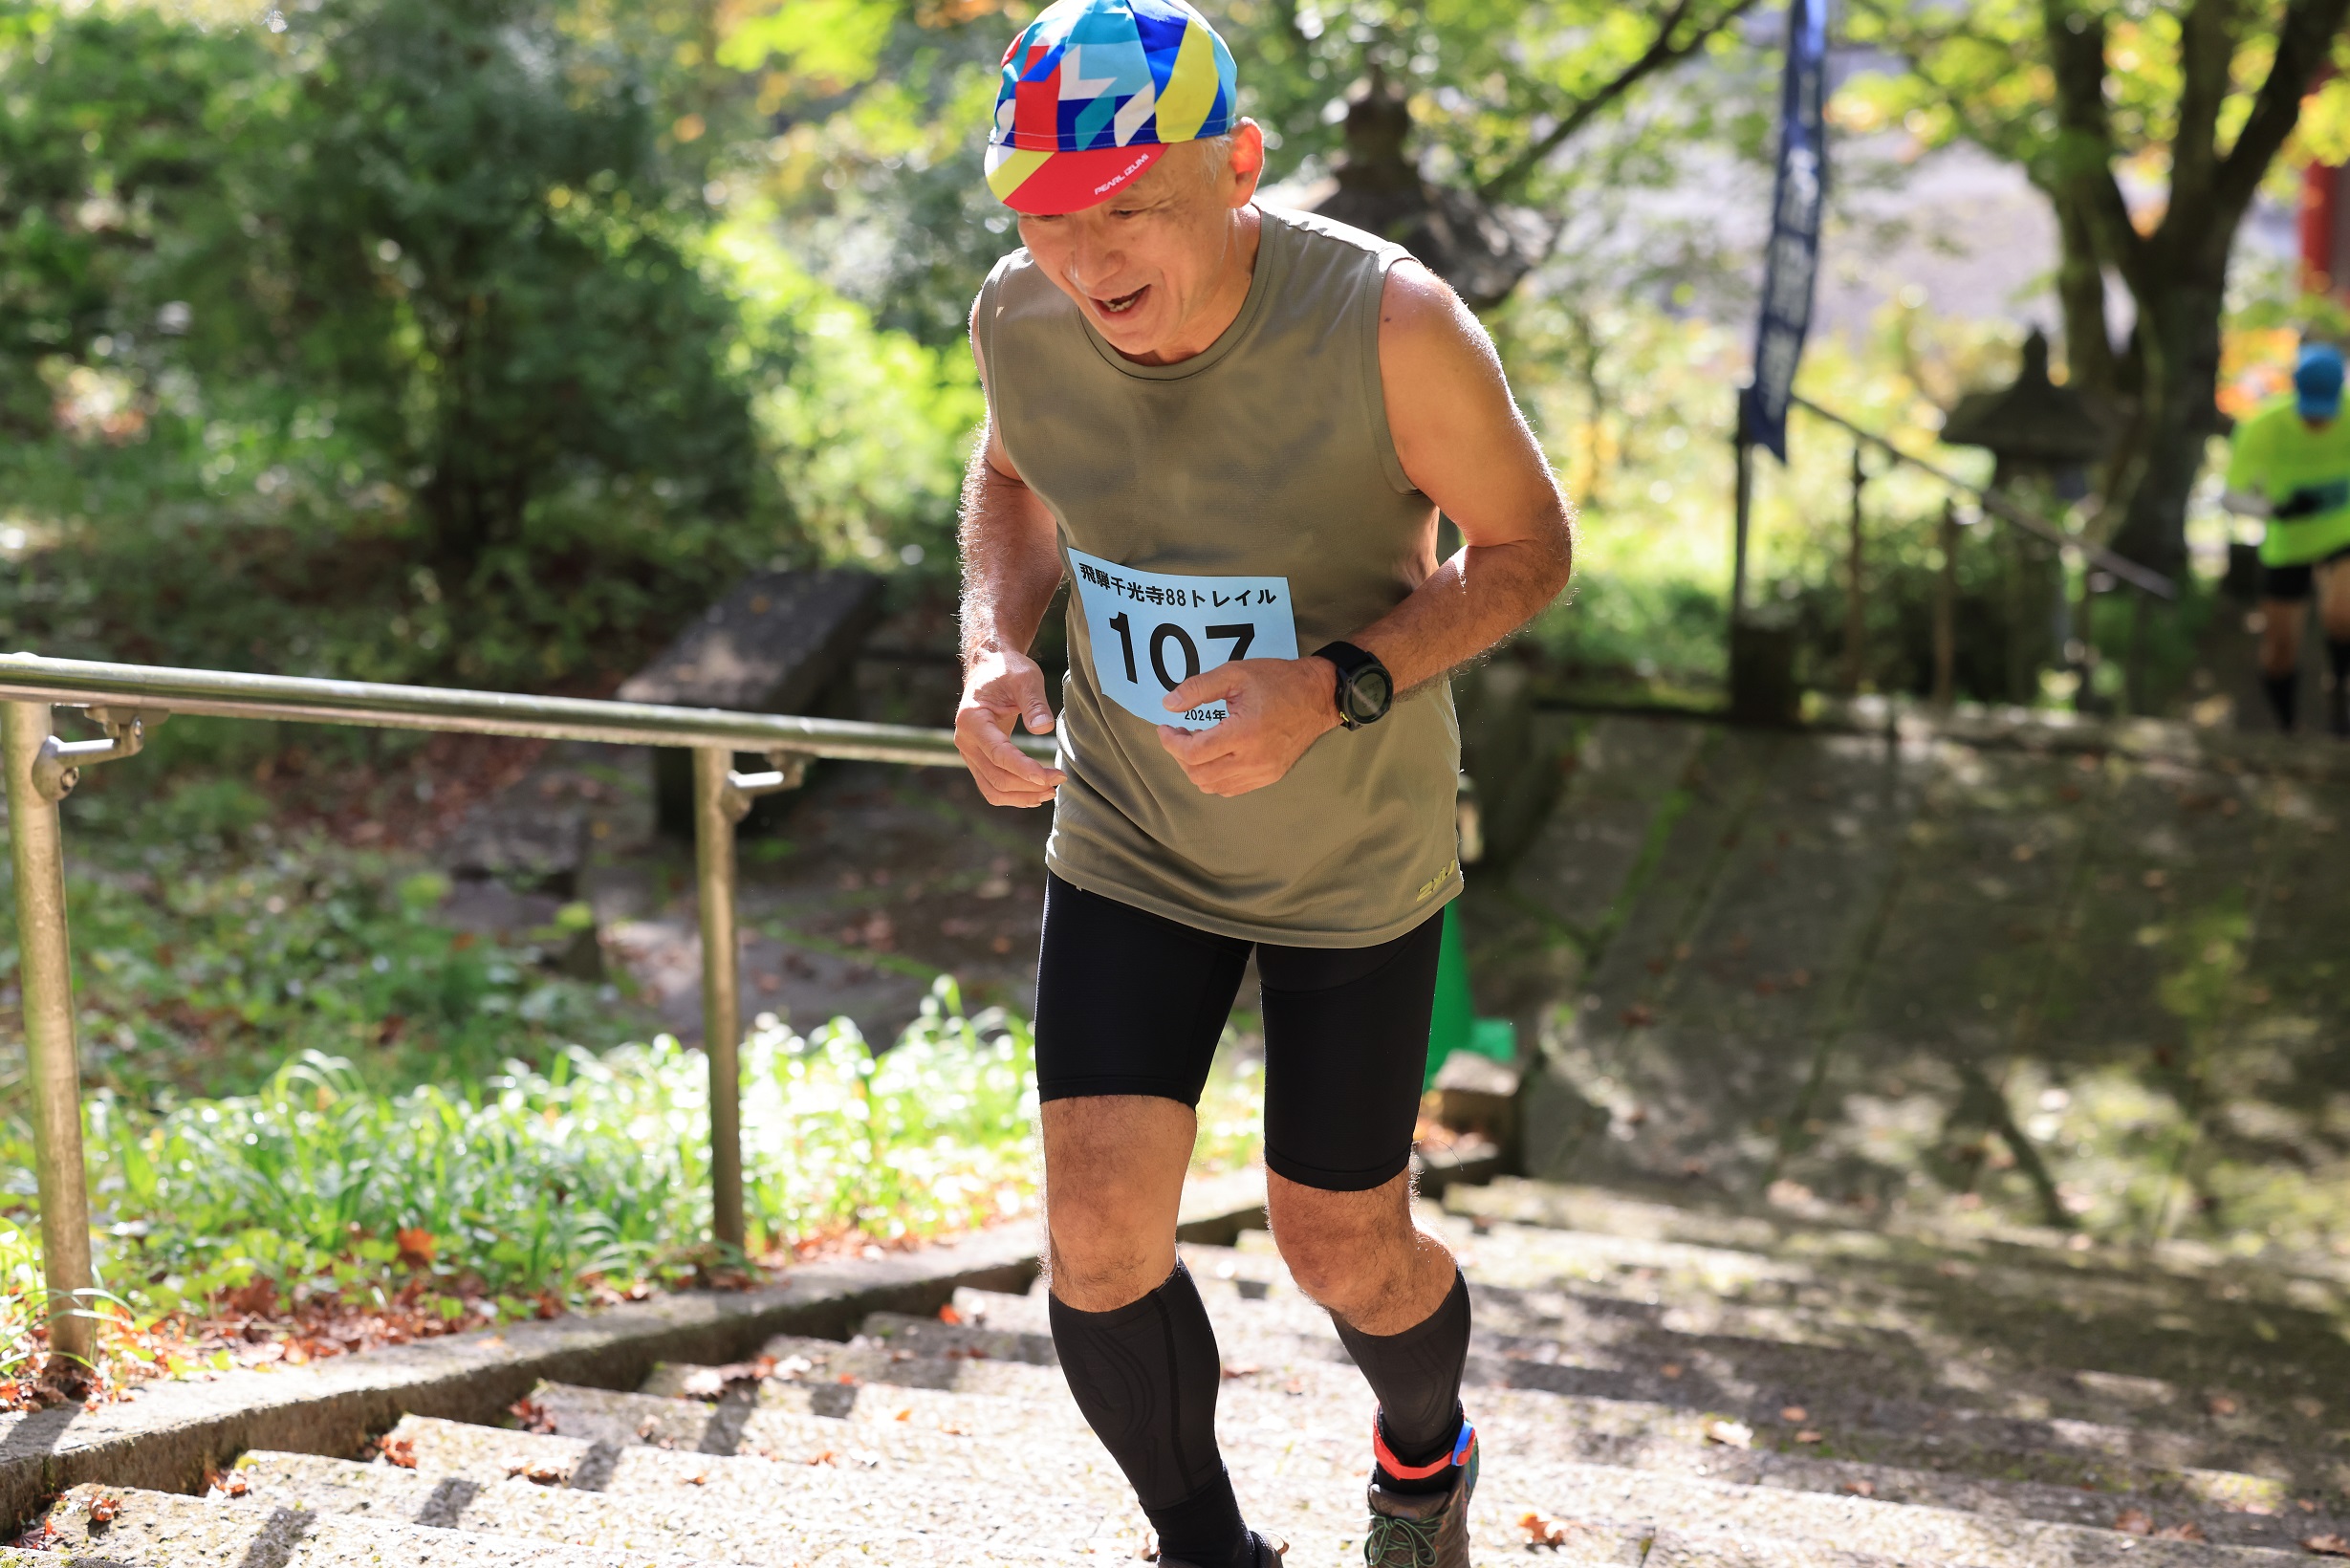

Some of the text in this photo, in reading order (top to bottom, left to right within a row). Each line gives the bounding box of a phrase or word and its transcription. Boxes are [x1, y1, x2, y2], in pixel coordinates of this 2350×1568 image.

[1094, 174, 1125, 195] PEARL
[1078, 562, 1277, 608] 飛騨千光寺88トレイル
[1184, 708, 1228, 722] 2024年
